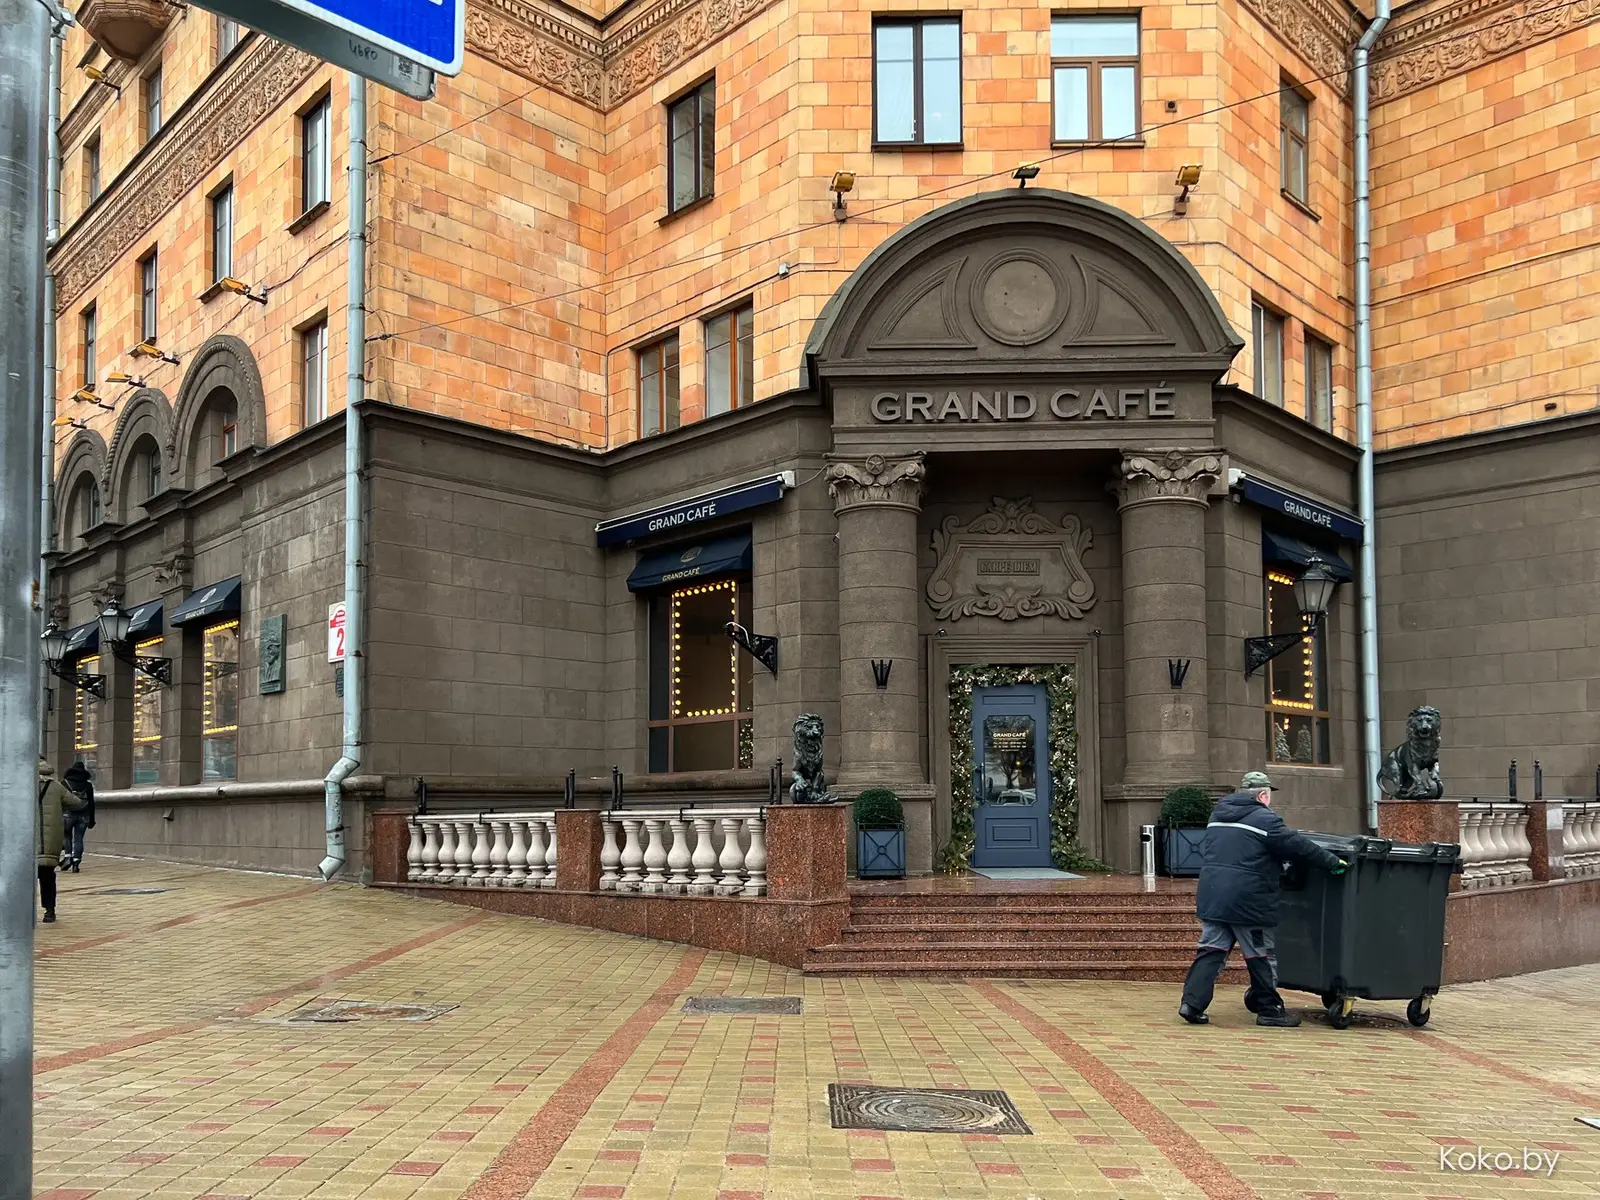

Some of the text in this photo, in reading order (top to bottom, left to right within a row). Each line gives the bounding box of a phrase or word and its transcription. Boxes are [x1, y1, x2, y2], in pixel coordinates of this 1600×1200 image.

[871, 381, 1176, 421] GRAND CAFÉ
[648, 501, 716, 532] GRAND CAFÉ
[1283, 500, 1332, 528] GRAND CAFÉ
[662, 566, 700, 582] GRAND CAFÉ
[1014, 561, 1037, 573] DIEM
